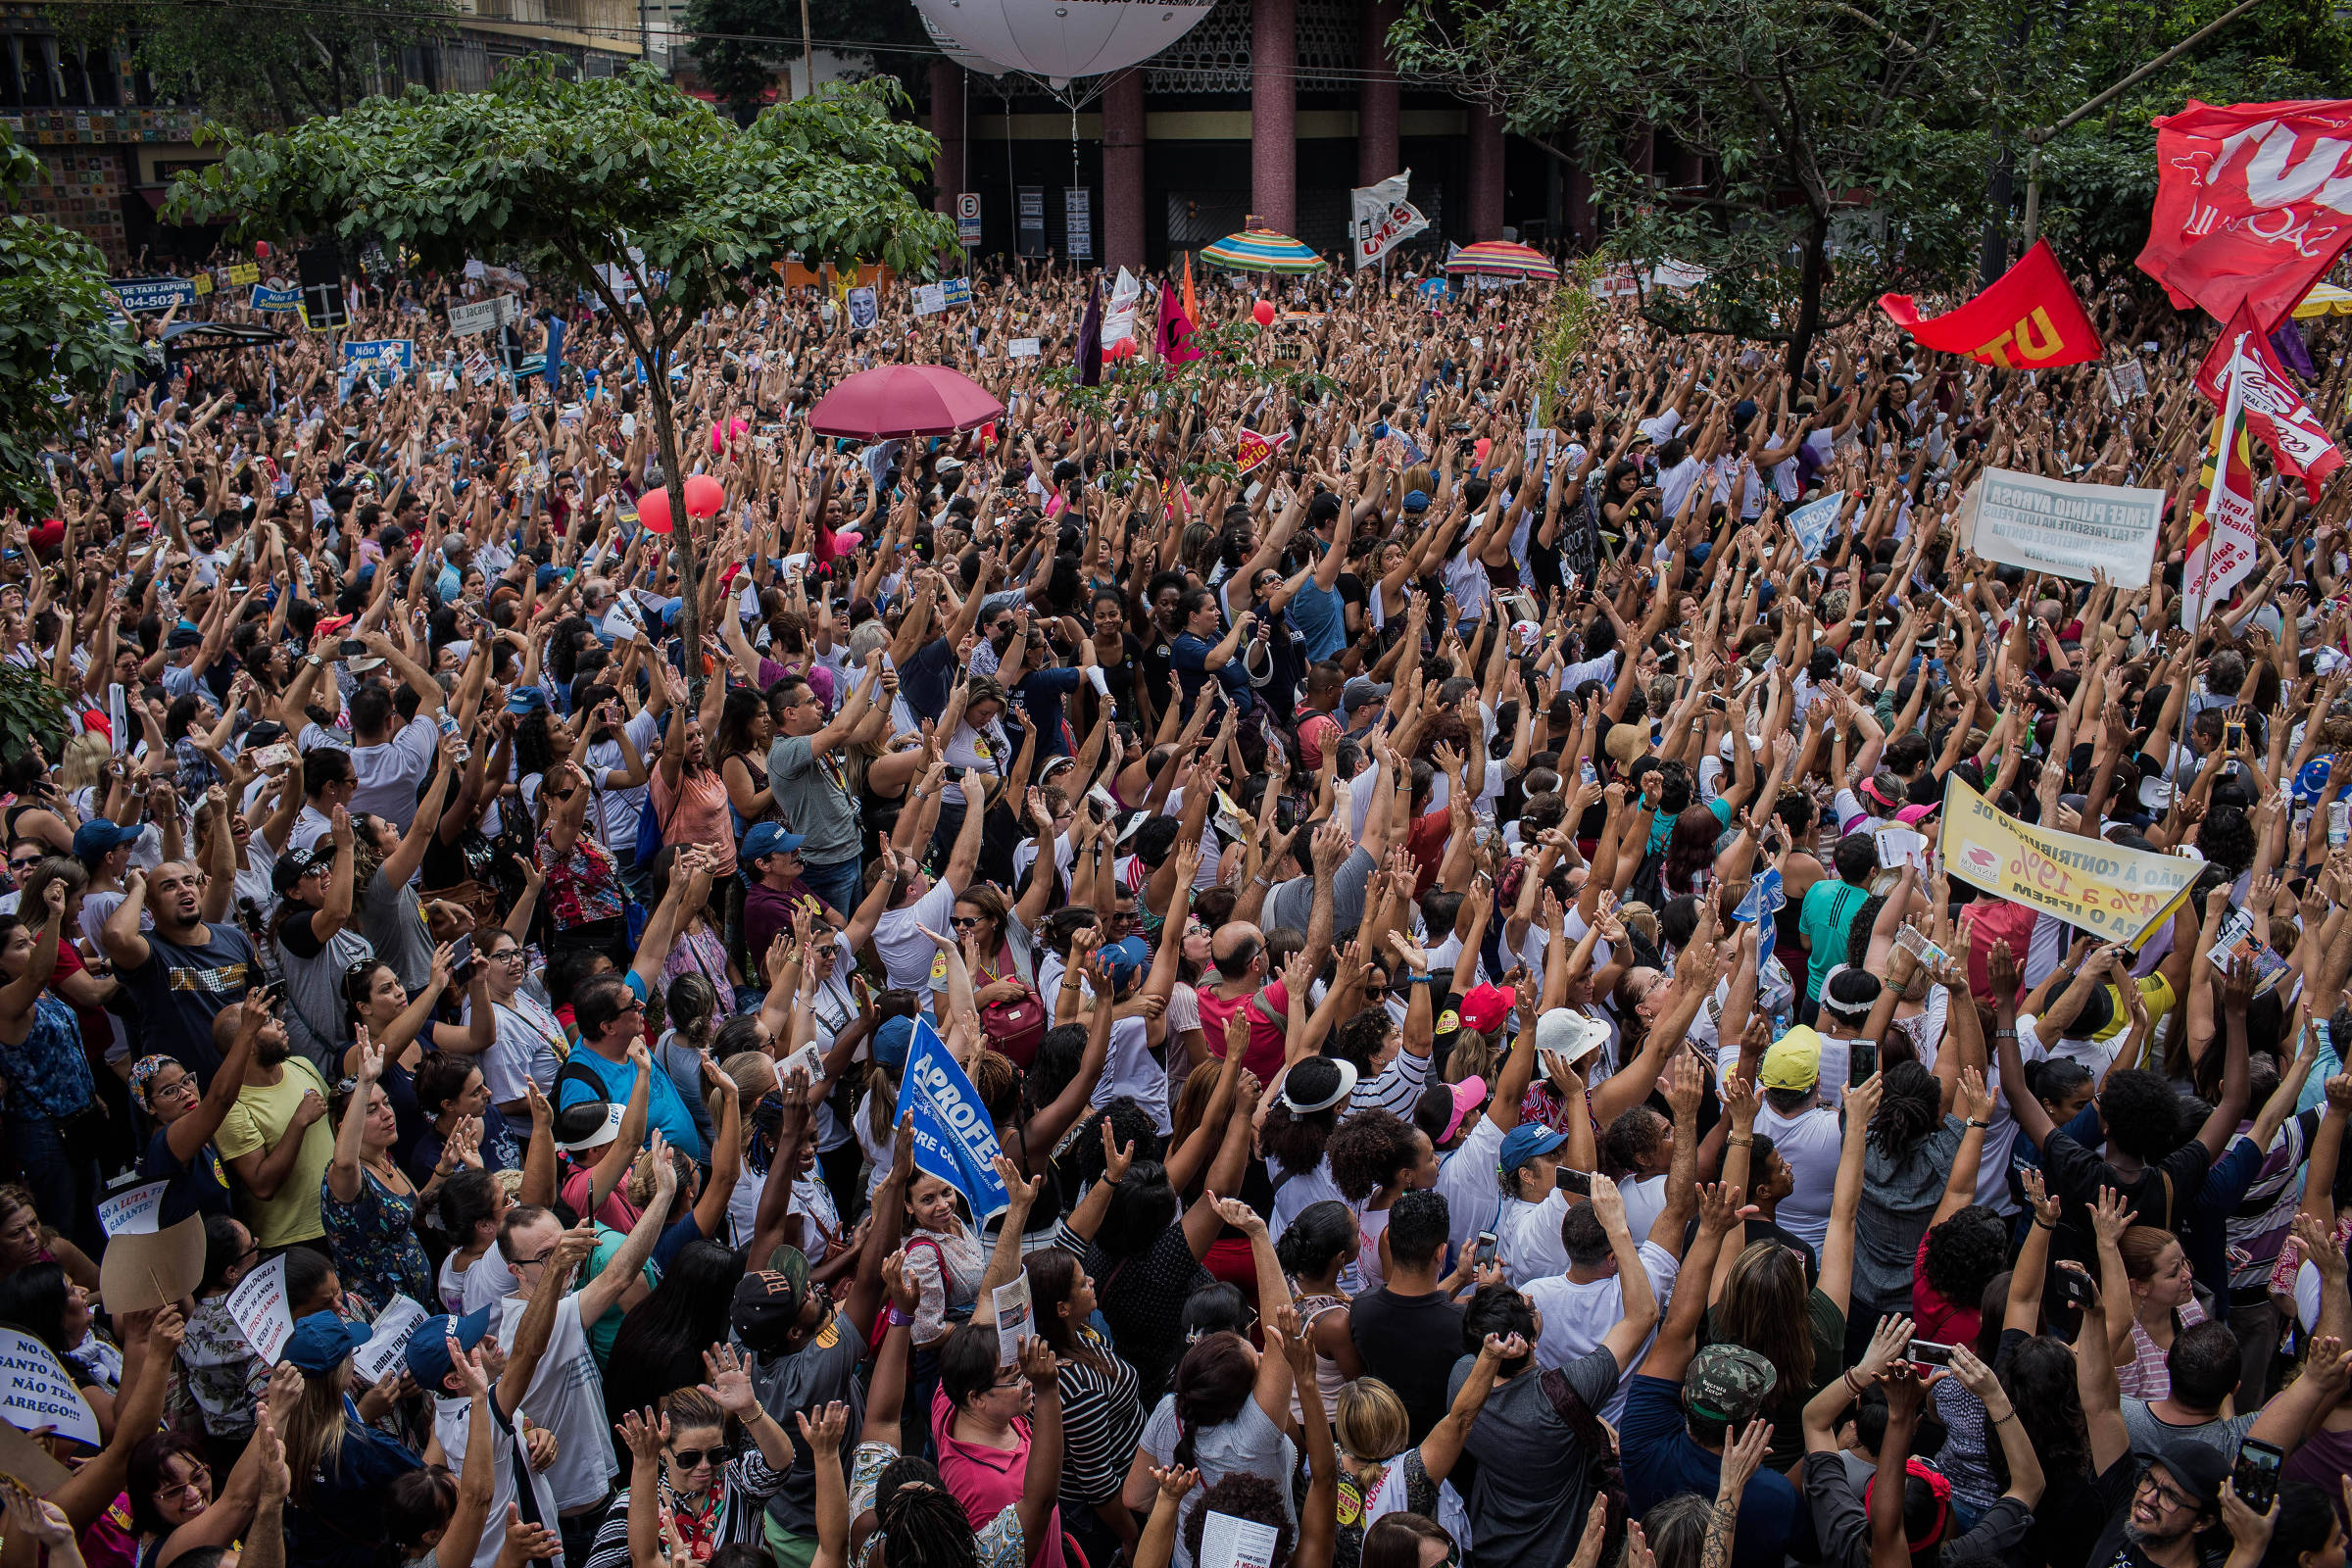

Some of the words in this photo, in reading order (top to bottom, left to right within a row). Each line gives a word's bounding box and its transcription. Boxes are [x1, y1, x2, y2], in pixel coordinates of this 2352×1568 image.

[965, 199, 973, 213] E
[158, 282, 192, 292] JAPURA
[268, 293, 285, 301] Não
[356, 345, 375, 356] Não
[914, 1053, 1005, 1190] APROFE
[101, 1207, 111, 1223] SÓ
[112, 1203, 119, 1214] A
[120, 1191, 147, 1209] LUTA
[109, 1200, 153, 1232] GARANTE!
[232, 1264, 276, 1314] APOSENTADORIA
[257, 1280, 274, 1301] ANOS
[263, 1292, 280, 1312] ANOS
[16, 1340, 38, 1354] NO
[372, 1349, 396, 1374] DORIA,
[392, 1332, 410, 1352] TIRA
[405, 1327, 412, 1336] A
[411, 1313, 424, 1331] MÃO
[11, 1376, 47, 1393] NÃO
[50, 1385, 77, 1404] TEM
[1703, 1379, 1727, 1393] Recruta
[2, 1395, 80, 1421] ARREGO!!!
[1338, 1492, 1360, 1513] REVE
